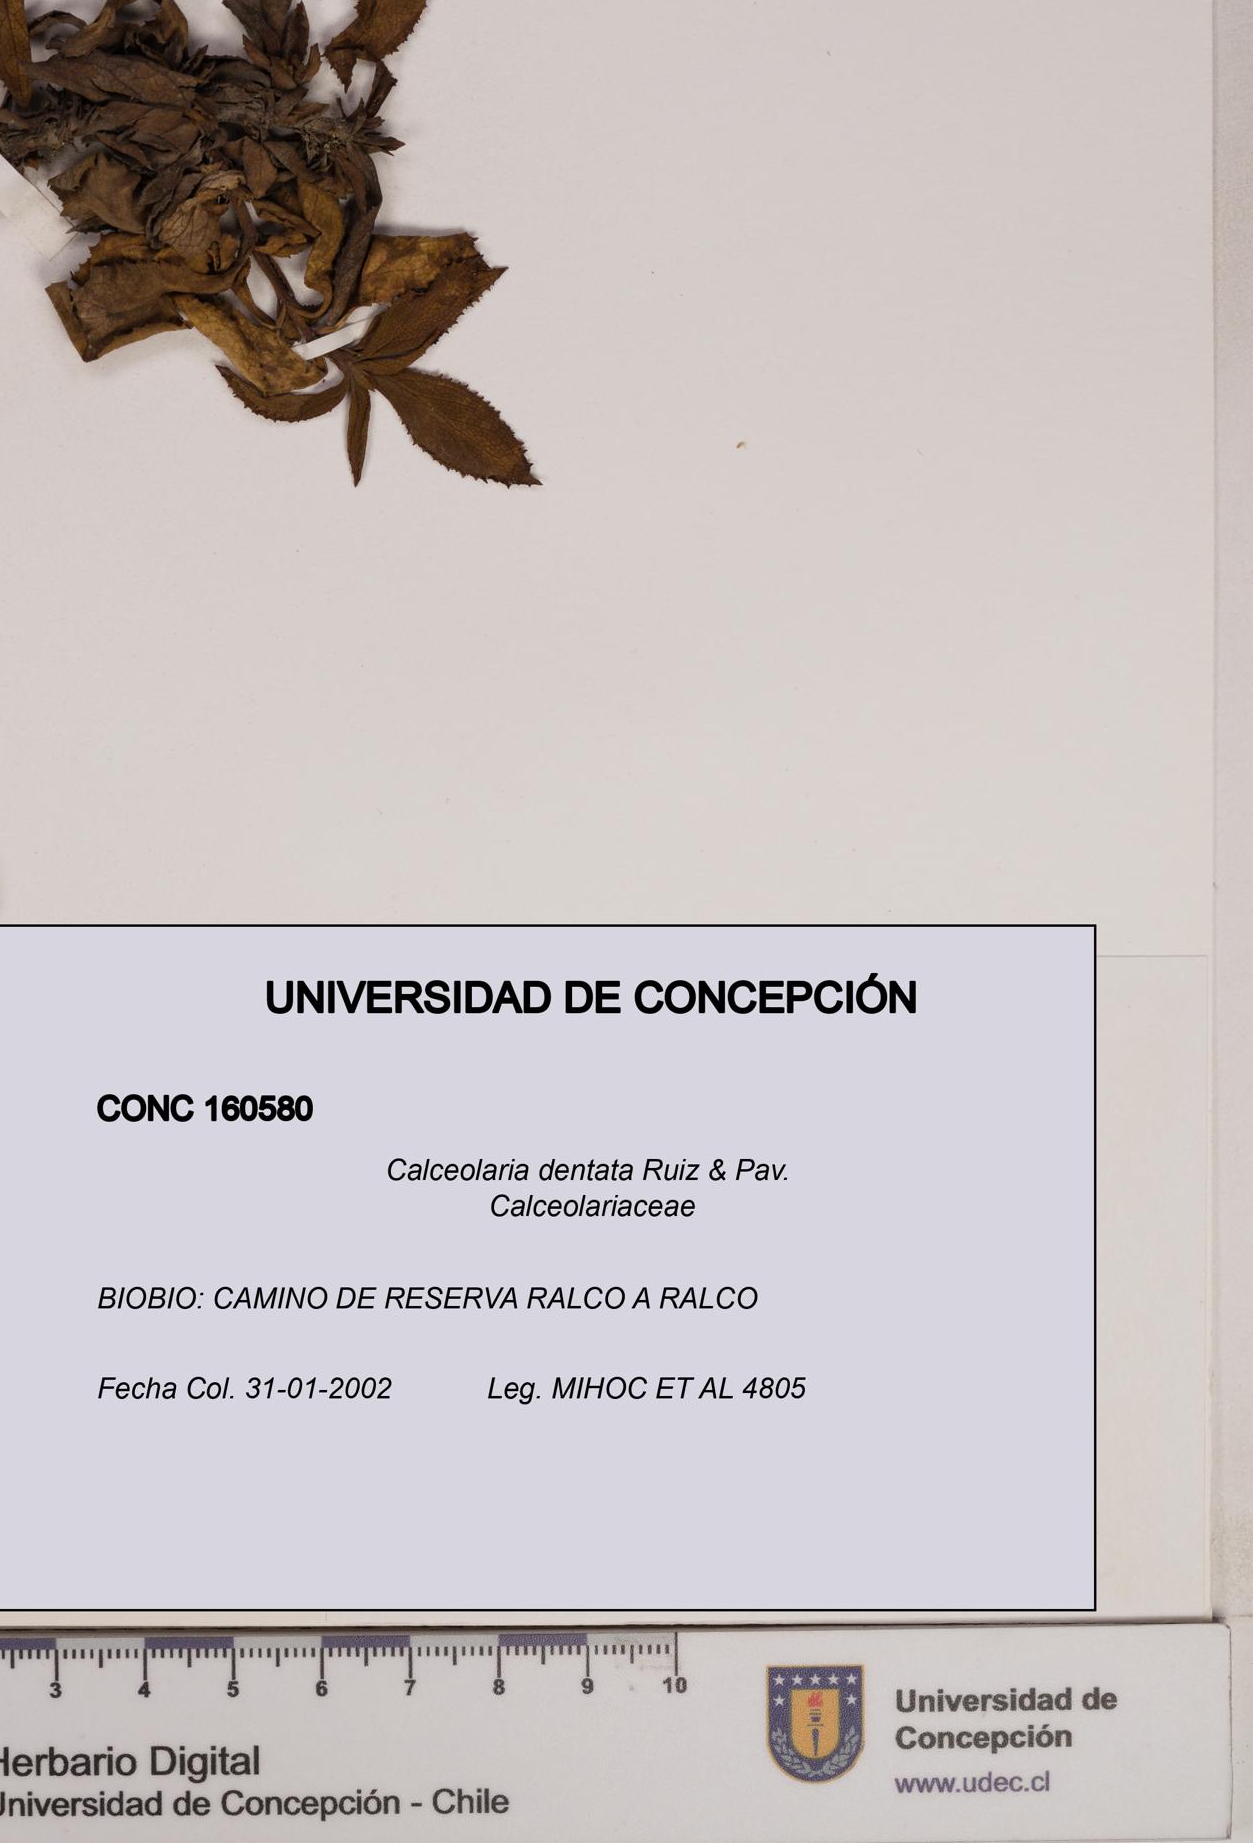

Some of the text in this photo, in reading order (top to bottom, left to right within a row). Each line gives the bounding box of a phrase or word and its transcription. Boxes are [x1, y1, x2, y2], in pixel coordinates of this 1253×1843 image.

[49, 1681, 63, 1699] 3
[137, 1680, 152, 1699] 4
[226, 1680, 240, 1698] 5
[315, 1679, 329, 1698] 6
[403, 1678, 417, 1697] 7
[492, 1678, 506, 1696] 8
[580, 1677, 594, 1695] 9
[662, 1676, 688, 1694] 10
[895, 1686, 1118, 1714] Universidad de
[894, 1723, 1073, 1755] Concepción
[150, 1744, 260, 1784] Digital
[894, 1770, 1050, 1794] www.udec.cl
[172, 1790, 211, 1817] de
[220, 1788, 401, 1822] Concepción
[432, 1787, 510, 1815] Chile
